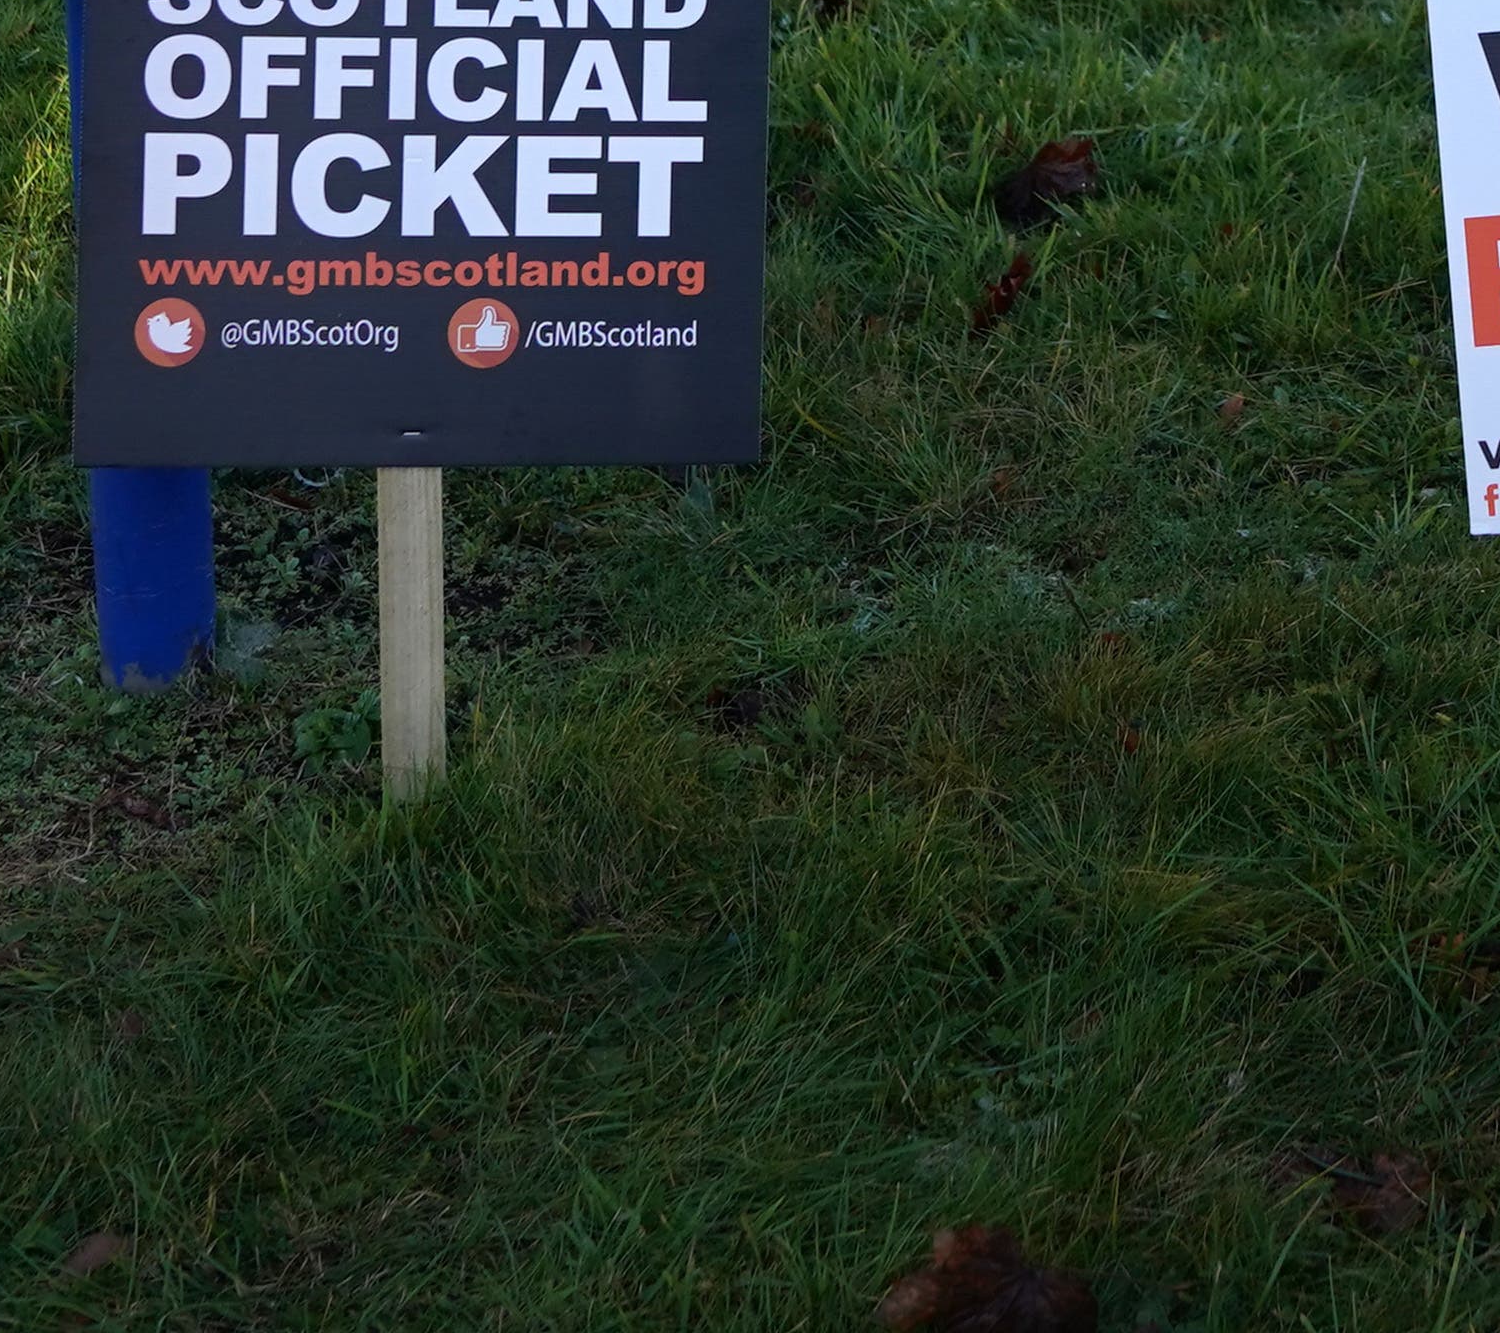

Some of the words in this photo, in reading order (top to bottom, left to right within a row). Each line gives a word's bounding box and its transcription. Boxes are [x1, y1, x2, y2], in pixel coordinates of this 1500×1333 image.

[144, 34, 708, 122] OFFICIAL
[141, 132, 704, 238] PICKET
[138, 252, 706, 295] www.gmbscotland.org
[221, 319, 399, 352] @GMBScotOrg
[524, 320, 698, 349] /GMBScotland
